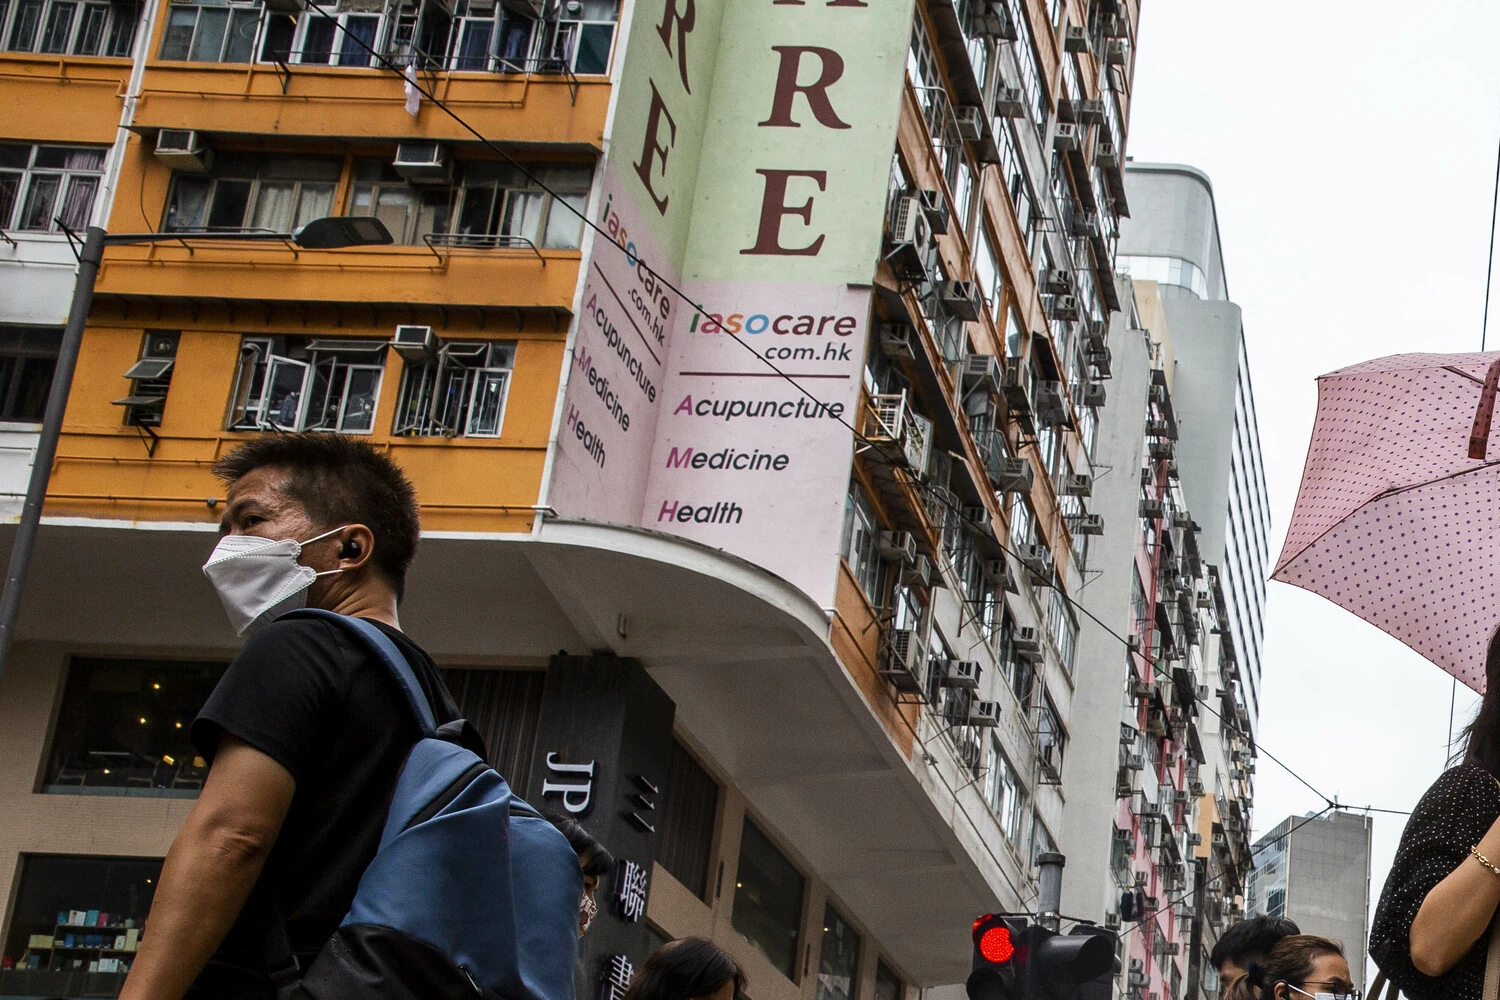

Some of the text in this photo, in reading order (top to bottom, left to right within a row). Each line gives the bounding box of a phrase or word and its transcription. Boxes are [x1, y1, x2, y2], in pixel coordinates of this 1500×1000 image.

[602, 192, 671, 320] iasocare
[586, 293, 657, 403] Acupuncture
[628, 288, 666, 348] .com.hk
[689, 304, 857, 337] iasocare
[757, 342, 853, 362] .com.hk
[577, 346, 631, 432] Medicine
[673, 394, 845, 421] Acupuncture
[566, 403, 607, 469] Health
[665, 446, 790, 471] Medicine
[657, 500, 743, 524] Health
[541, 751, 595, 813] JP
